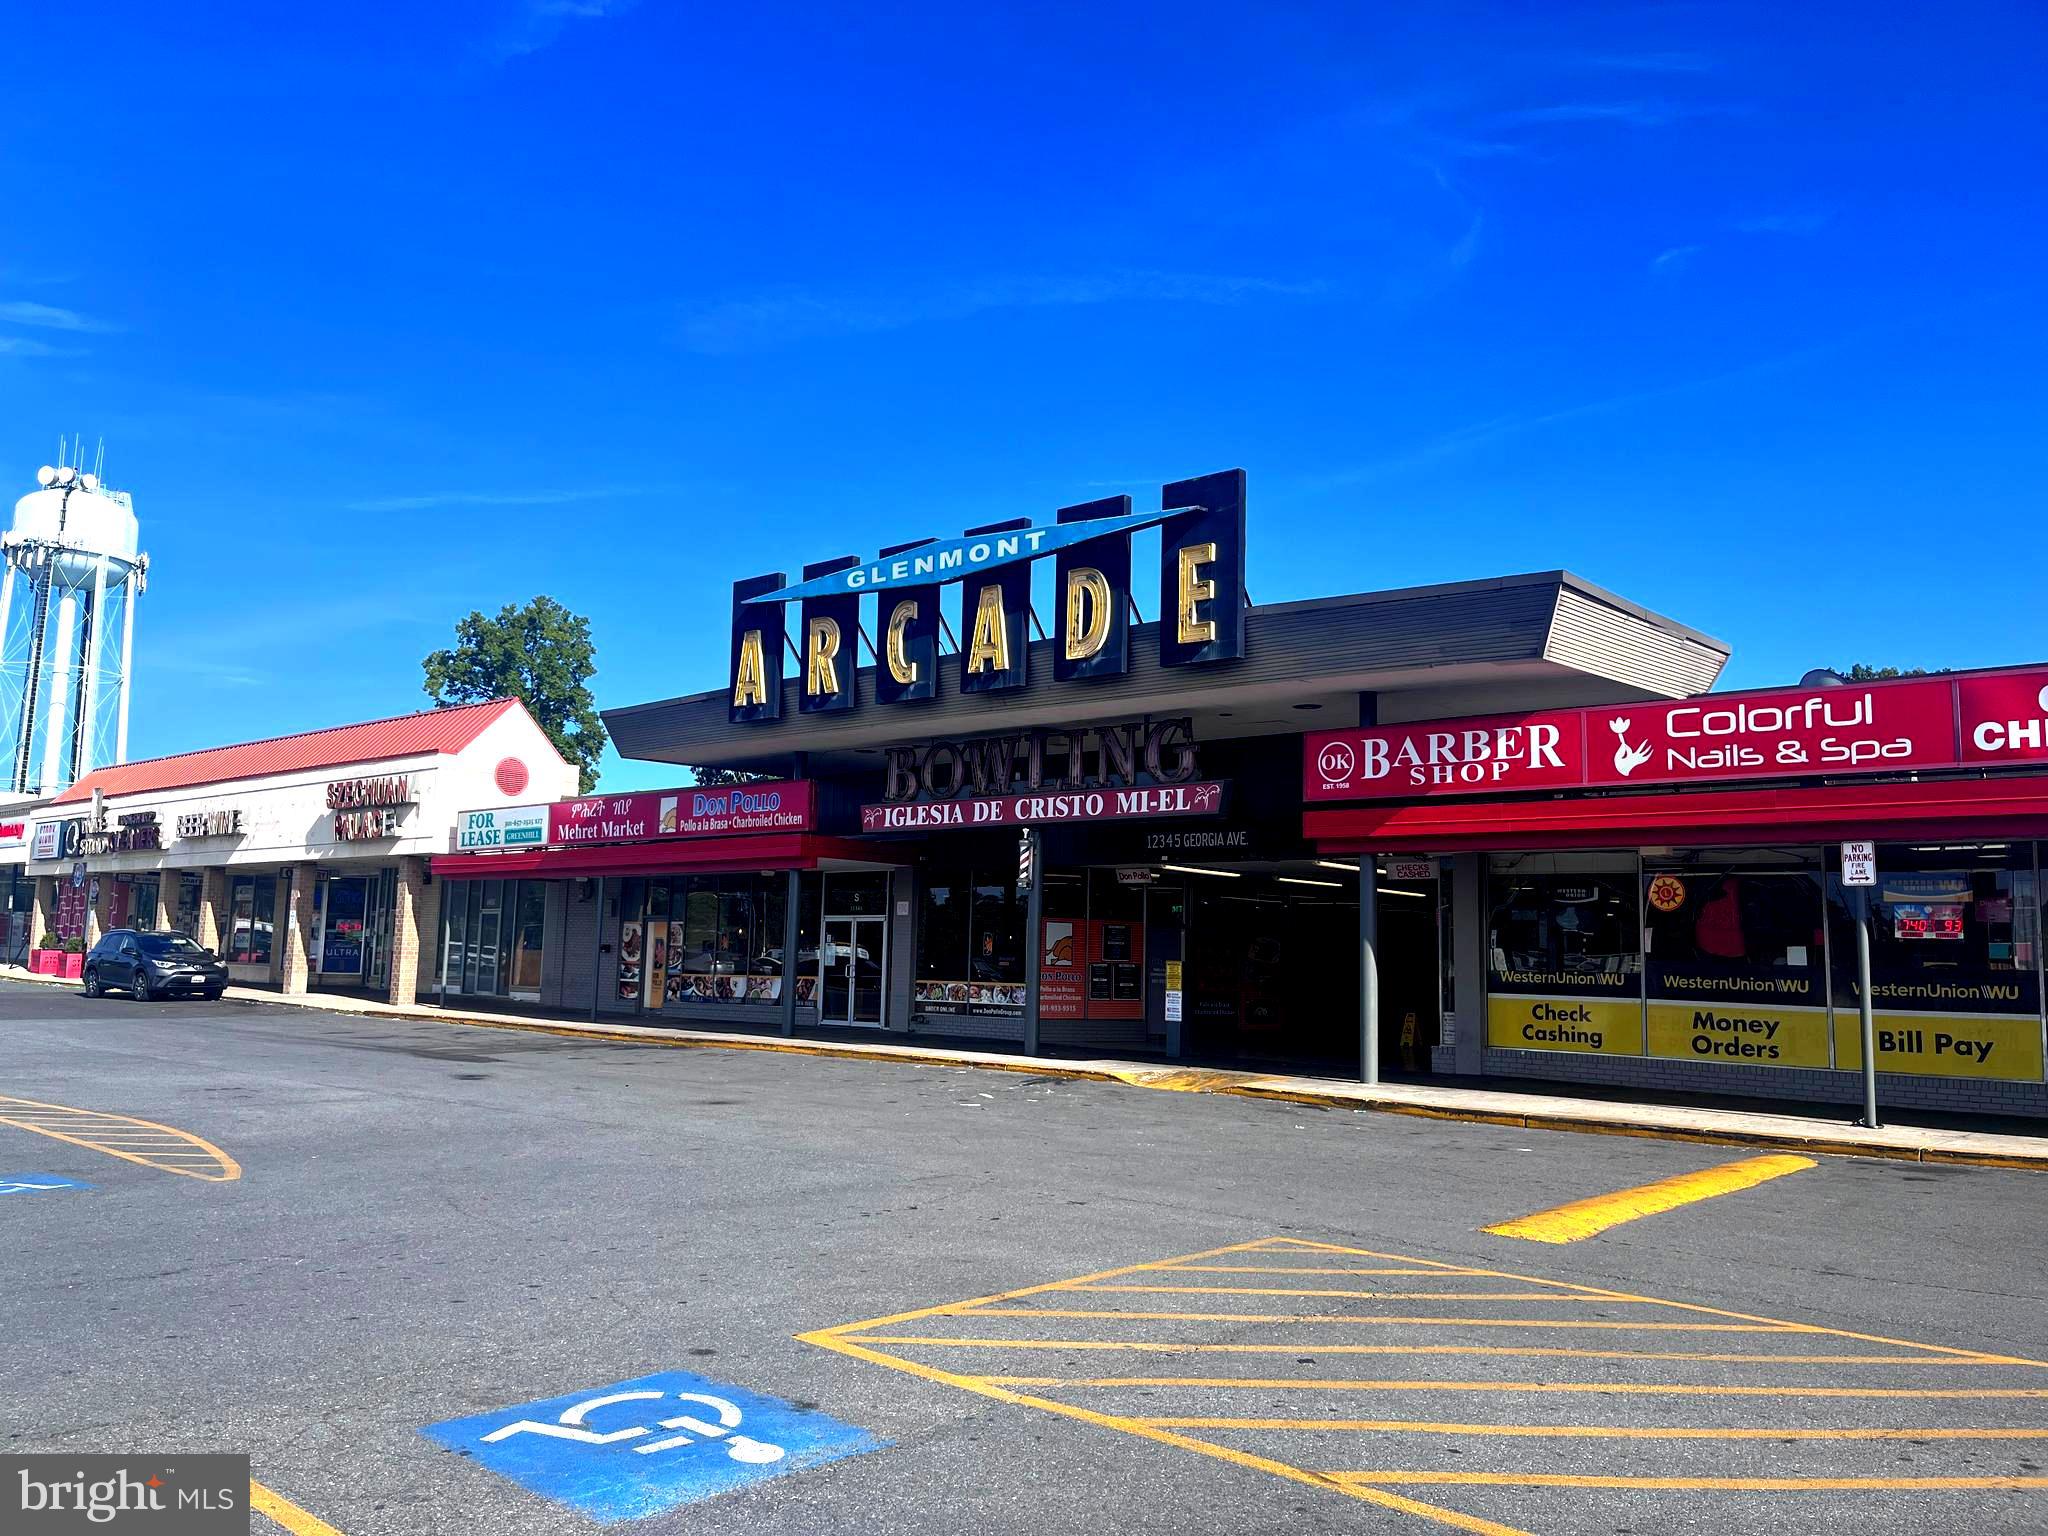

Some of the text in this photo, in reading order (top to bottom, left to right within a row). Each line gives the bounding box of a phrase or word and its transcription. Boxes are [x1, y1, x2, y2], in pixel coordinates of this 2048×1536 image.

[846, 530, 1047, 589] GLENMONT
[734, 542, 1217, 708] ARCADE
[1666, 693, 1873, 738] Colorful
[1973, 719, 2048, 750] CH
[884, 716, 1199, 801] BOWLING
[1321, 754, 1350, 770] OK
[1361, 724, 1565, 780] BARBER
[1667, 737, 1912, 771] Nails & Spa
[1409, 761, 1510, 786] SHOP
[326, 775, 409, 809] SZECHUAN
[884, 788, 1190, 828] IGLESIA DE CRISTO MI-EL
[334, 809, 396, 841] PALACE
[468, 813, 494, 829] FOR
[558, 820, 645, 841] Mehret Market
[680, 813, 802, 832] Pollo a la Brasa Charbroiled Chicken
[461, 830, 501, 847] LEASE
[506, 830, 540, 841] GREENHILL
[1147, 831, 1249, 849] 12345 GEORGIA AVE.
[1844, 853, 1873, 862] PARKING
[1851, 844, 1864, 853] NO
[325, 948, 359, 957] ULTRA
[1500, 971, 1595, 985] WesternUnion
[1664, 975, 1775, 992] WesternUnion
[1532, 1004, 1592, 1023] Check
[1692, 1011, 1780, 1040] Money
[1522, 1023, 1603, 1048] Cashing
[1692, 1035, 1780, 1059] Orders
[1878, 1030, 1994, 1063] Bill Pay
